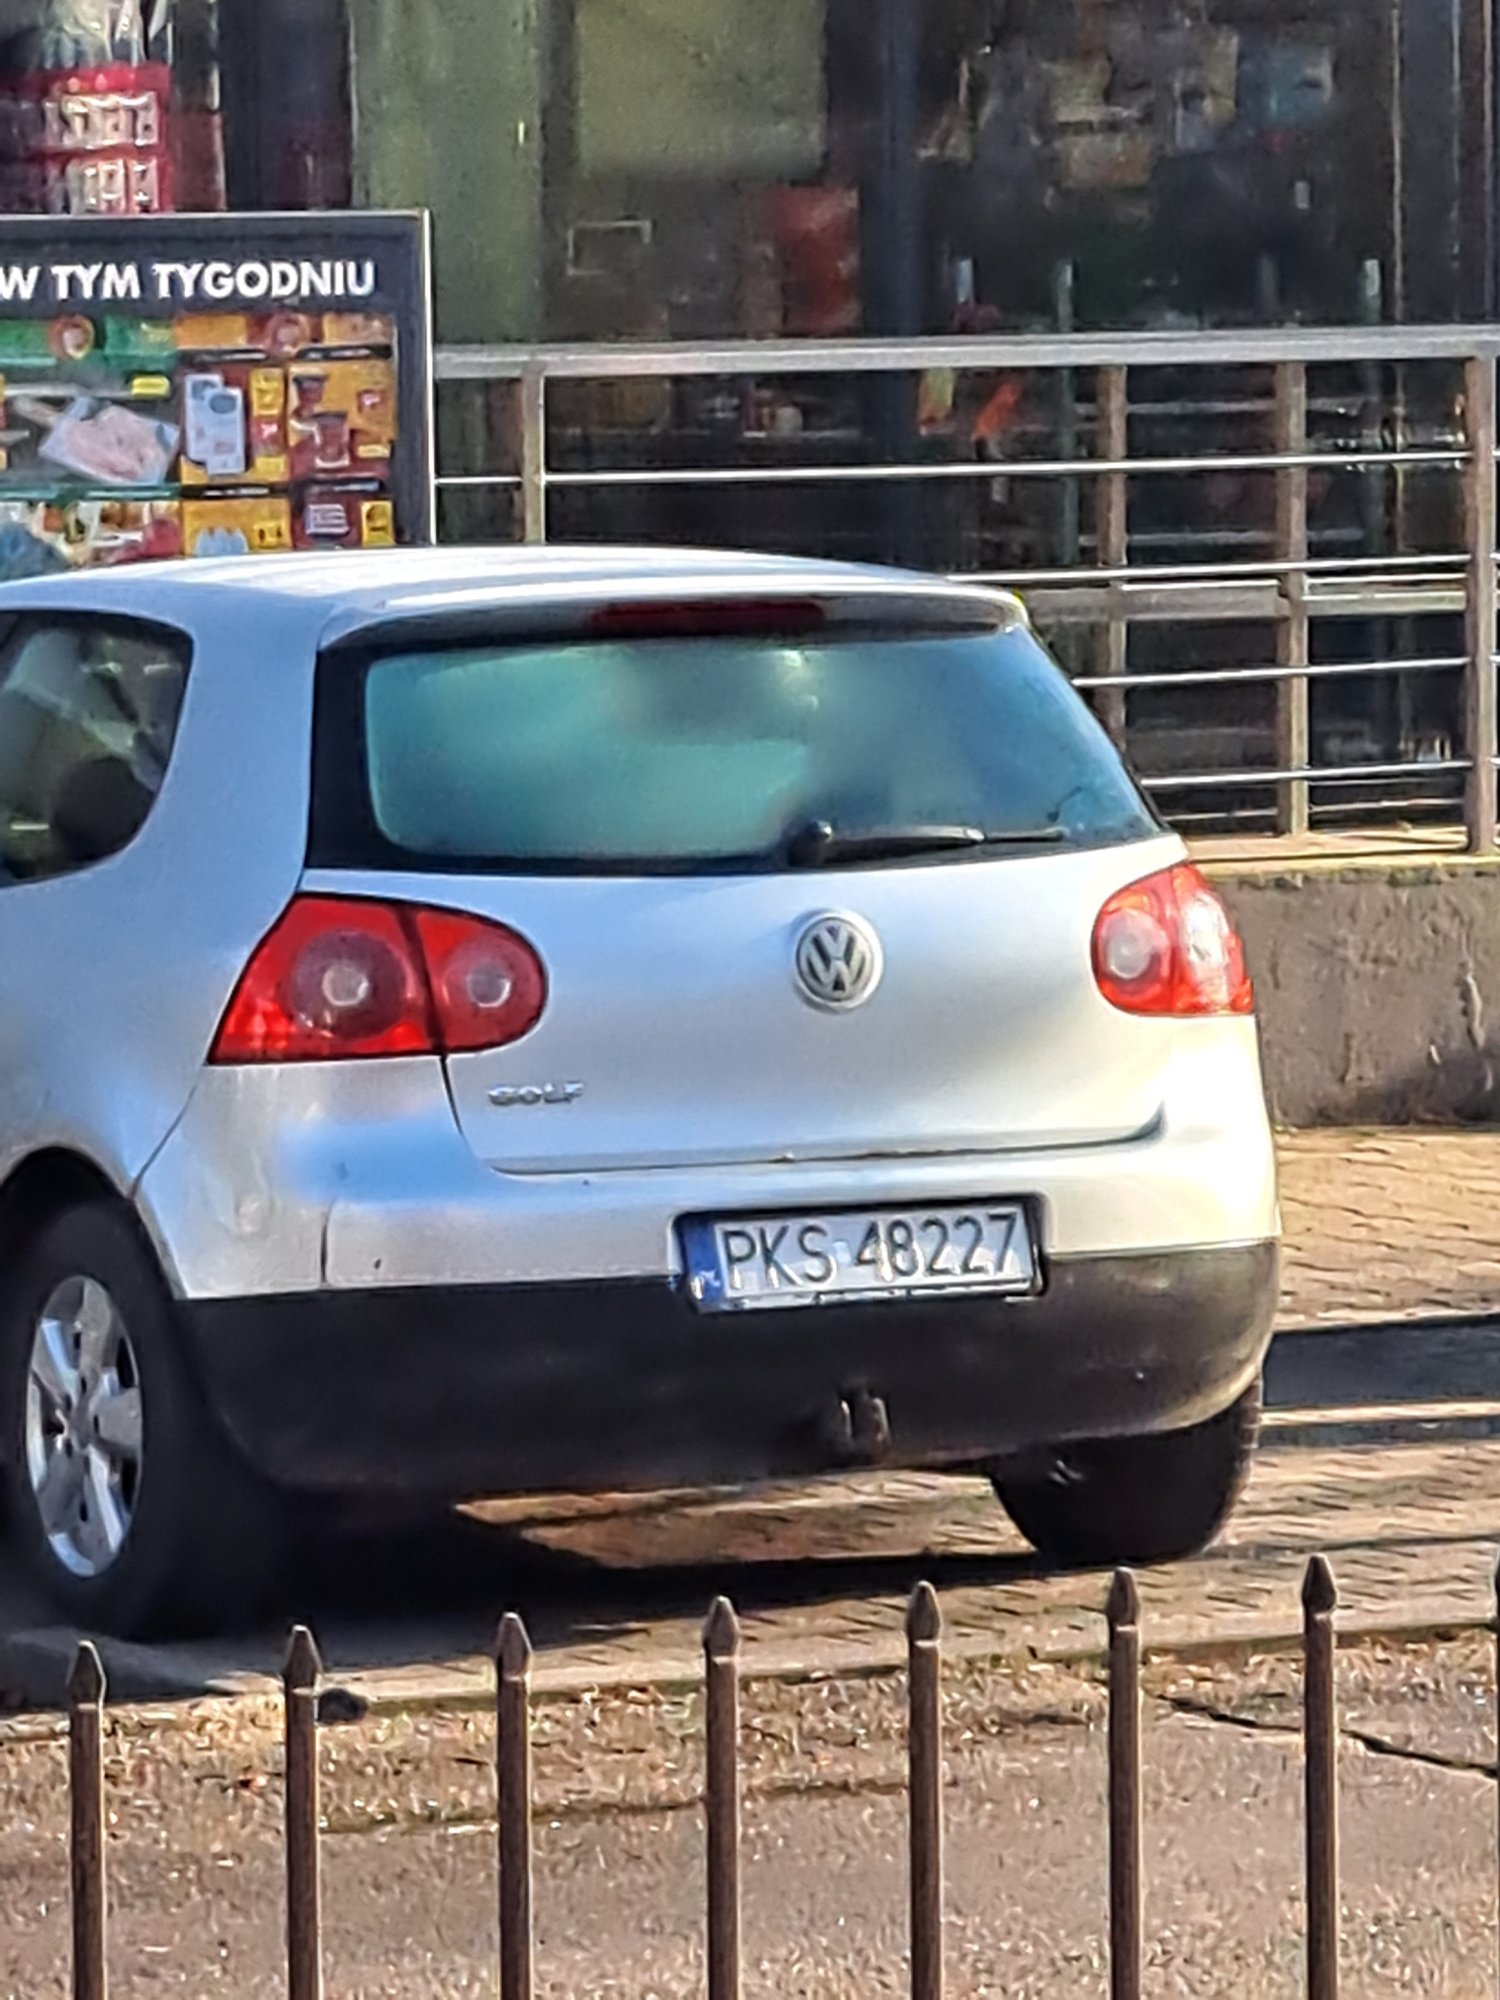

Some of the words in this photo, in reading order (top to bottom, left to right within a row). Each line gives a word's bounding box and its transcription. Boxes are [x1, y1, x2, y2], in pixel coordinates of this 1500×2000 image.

[0, 264, 40, 300] W
[50, 261, 141, 300] TYM
[152, 260, 375, 299] TYGODNIU
[487, 1080, 585, 1107] GOLF
[722, 1224, 838, 1291] PKS
[854, 1211, 1019, 1283] 48227
